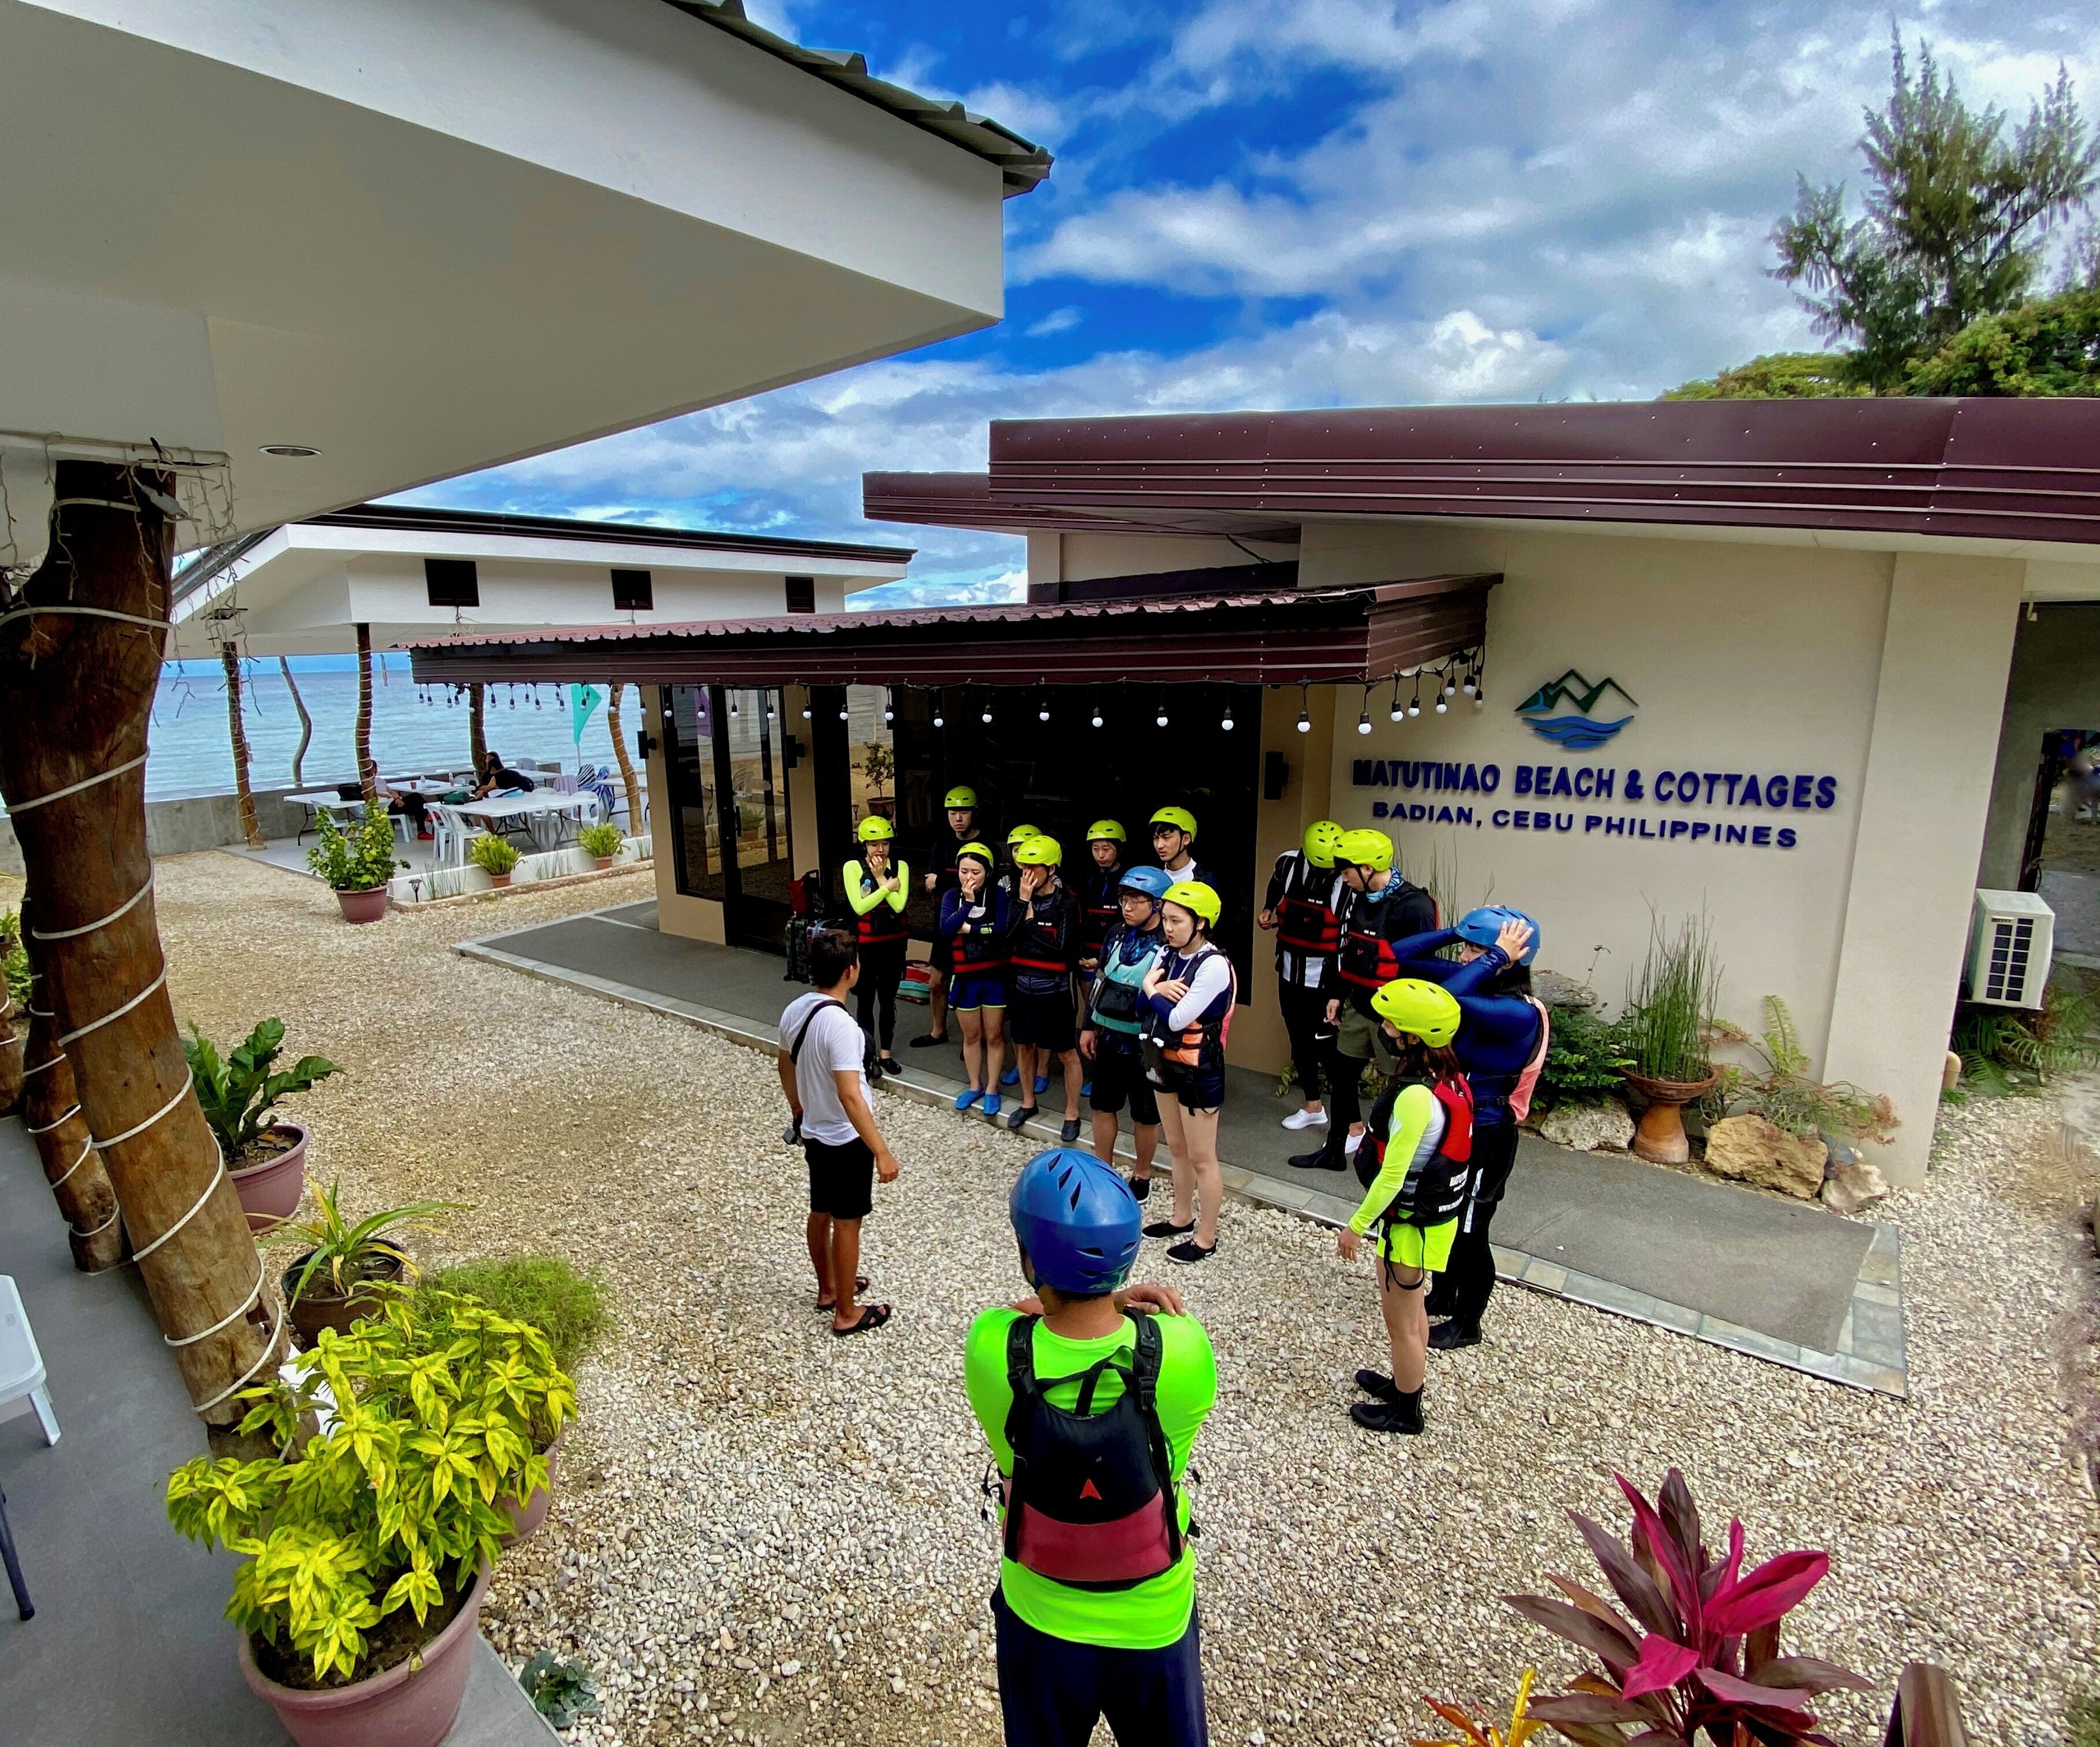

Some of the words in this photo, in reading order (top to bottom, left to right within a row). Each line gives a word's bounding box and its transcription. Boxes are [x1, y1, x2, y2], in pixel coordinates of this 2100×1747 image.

[1352, 759, 1501, 796] MATUTINAO
[1515, 765, 1616, 799] BEACH
[1624, 769, 1645, 801] &
[1654, 771, 1837, 809] COTTAGES
[1372, 801, 1482, 828] BADIAN,
[1492, 809, 1574, 832] CEBU
[1585, 815, 1797, 848] PHILIPPINES
